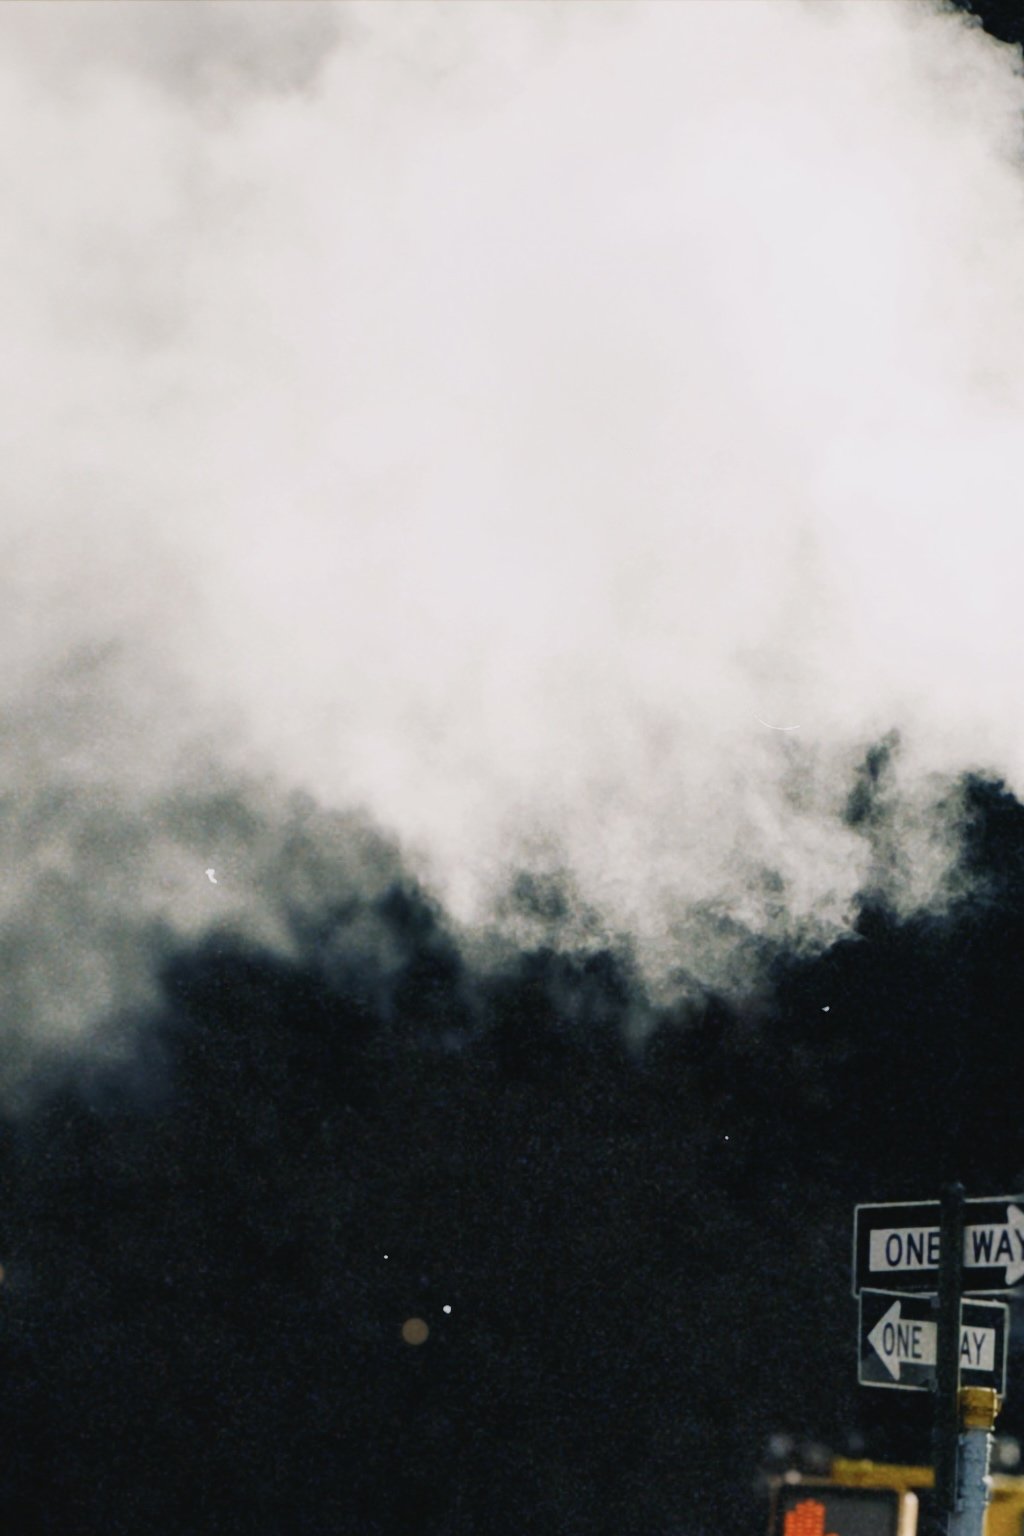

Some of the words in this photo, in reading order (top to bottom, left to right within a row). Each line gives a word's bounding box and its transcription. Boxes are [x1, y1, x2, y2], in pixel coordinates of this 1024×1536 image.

[885, 1231, 941, 1267] ONE
[882, 1322, 923, 1359] ONE
[959, 1331, 986, 1366] AY
